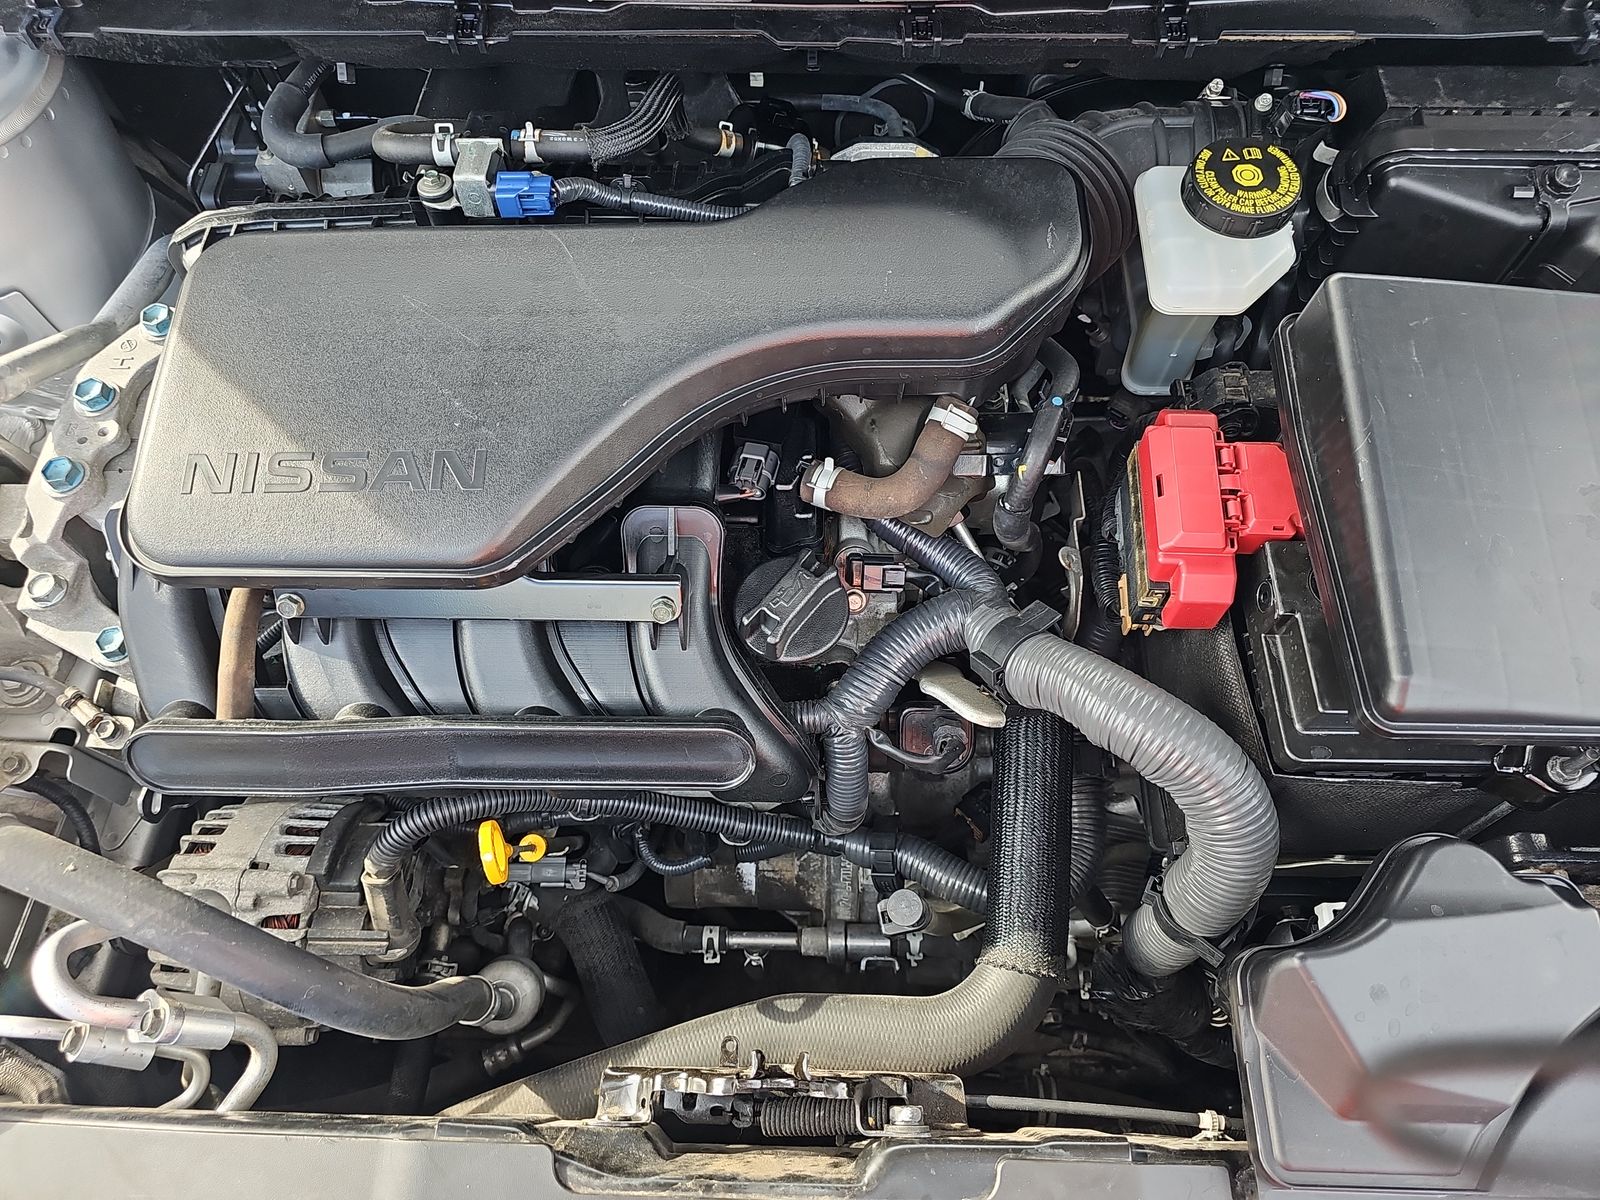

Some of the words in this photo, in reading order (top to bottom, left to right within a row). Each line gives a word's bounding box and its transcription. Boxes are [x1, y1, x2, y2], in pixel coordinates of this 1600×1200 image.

[1267, 144, 1298, 172] CONTAINER
[1203, 187, 1216, 198] OR
[1205, 170, 1221, 191] CLEAN
[1215, 187, 1239, 204] FILLER
[1239, 198, 1254, 207] CAP
[1255, 191, 1283, 207] BEFORE
[1277, 165, 1290, 195] REMOVING
[1237, 187, 1272, 200] WARNING
[1212, 194, 1231, 208] DOT4
[1273, 194, 1294, 210] FROM
[1230, 203, 1255, 214] BRAKE
[1255, 204, 1277, 214] FLUID
[181, 449, 488, 495] NISSAN
